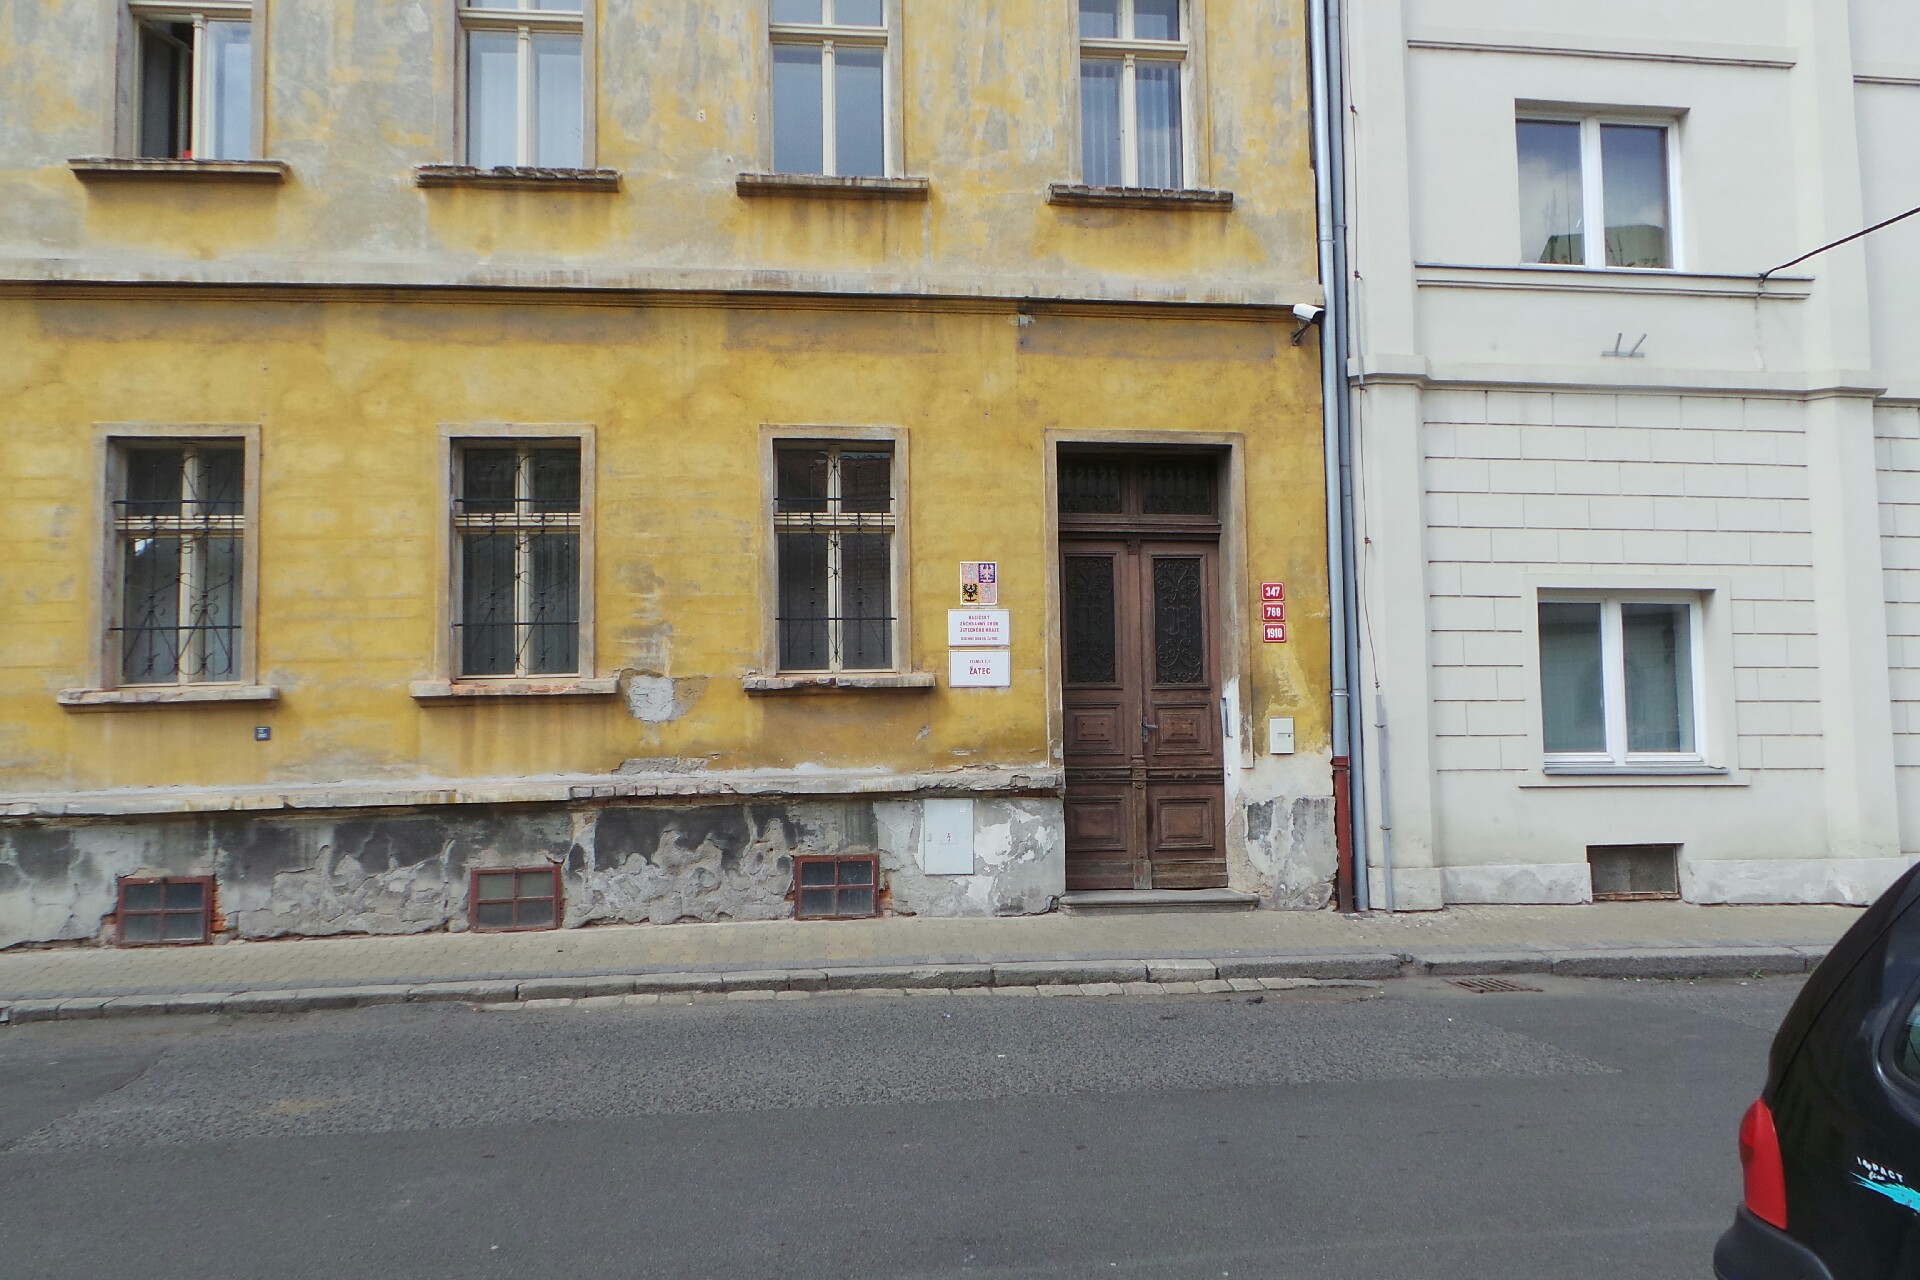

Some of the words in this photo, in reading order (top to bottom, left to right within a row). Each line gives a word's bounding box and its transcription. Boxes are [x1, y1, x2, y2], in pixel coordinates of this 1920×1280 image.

[1265, 586, 1280, 597] 347
[1266, 607, 1281, 617] 768
[1266, 628, 1283, 639] 1910
[969, 666, 991, 675] ŽATEC
[1856, 1155, 1904, 1184] IMPACT
